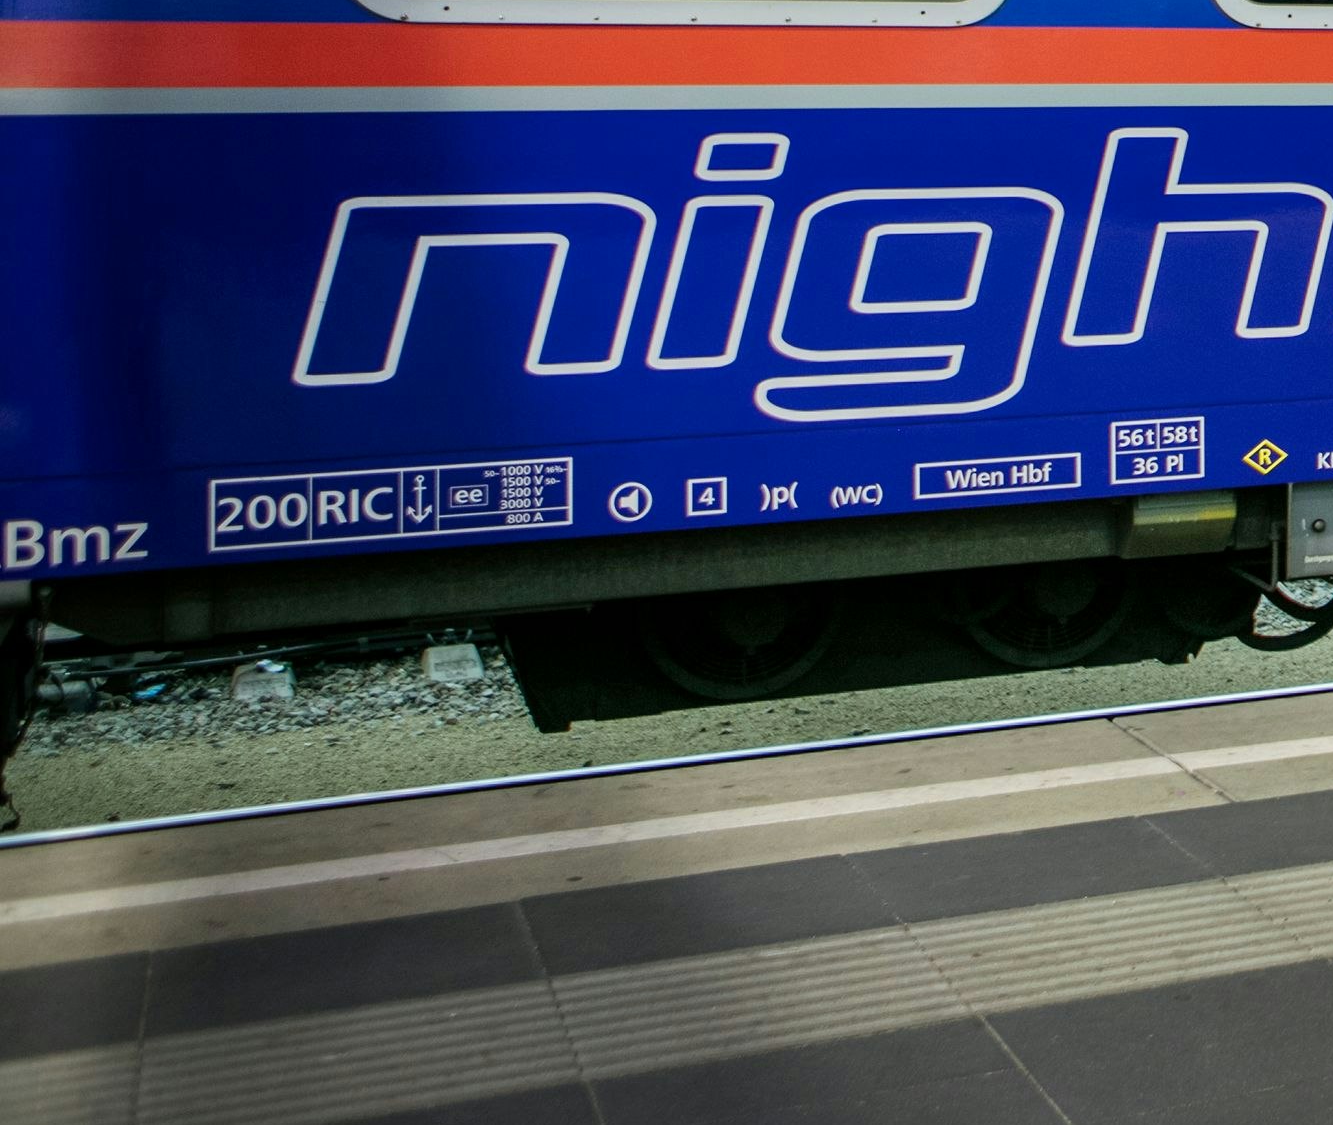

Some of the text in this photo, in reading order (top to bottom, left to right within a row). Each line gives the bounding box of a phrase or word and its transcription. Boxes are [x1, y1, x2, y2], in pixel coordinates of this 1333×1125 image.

[1117, 424, 1198, 447] 56t 58t
[1258, 448, 1272, 465] R
[501, 465, 531, 476] 1000
[1133, 457, 1158, 475] 36
[502, 476, 531, 487] 1500
[945, 462, 1054, 491] Wien Hbf
[455, 488, 483, 504] ee
[502, 487, 531, 498] 1500
[699, 487, 715, 505] 4
[830, 484, 882, 508] (WC)
[214, 493, 307, 533] 200
[318, 487, 393, 525] RIC
[500, 498, 531, 510] 3000
[506, 512, 544, 524] 800 A
[0, 520, 147, 569] Bmz
